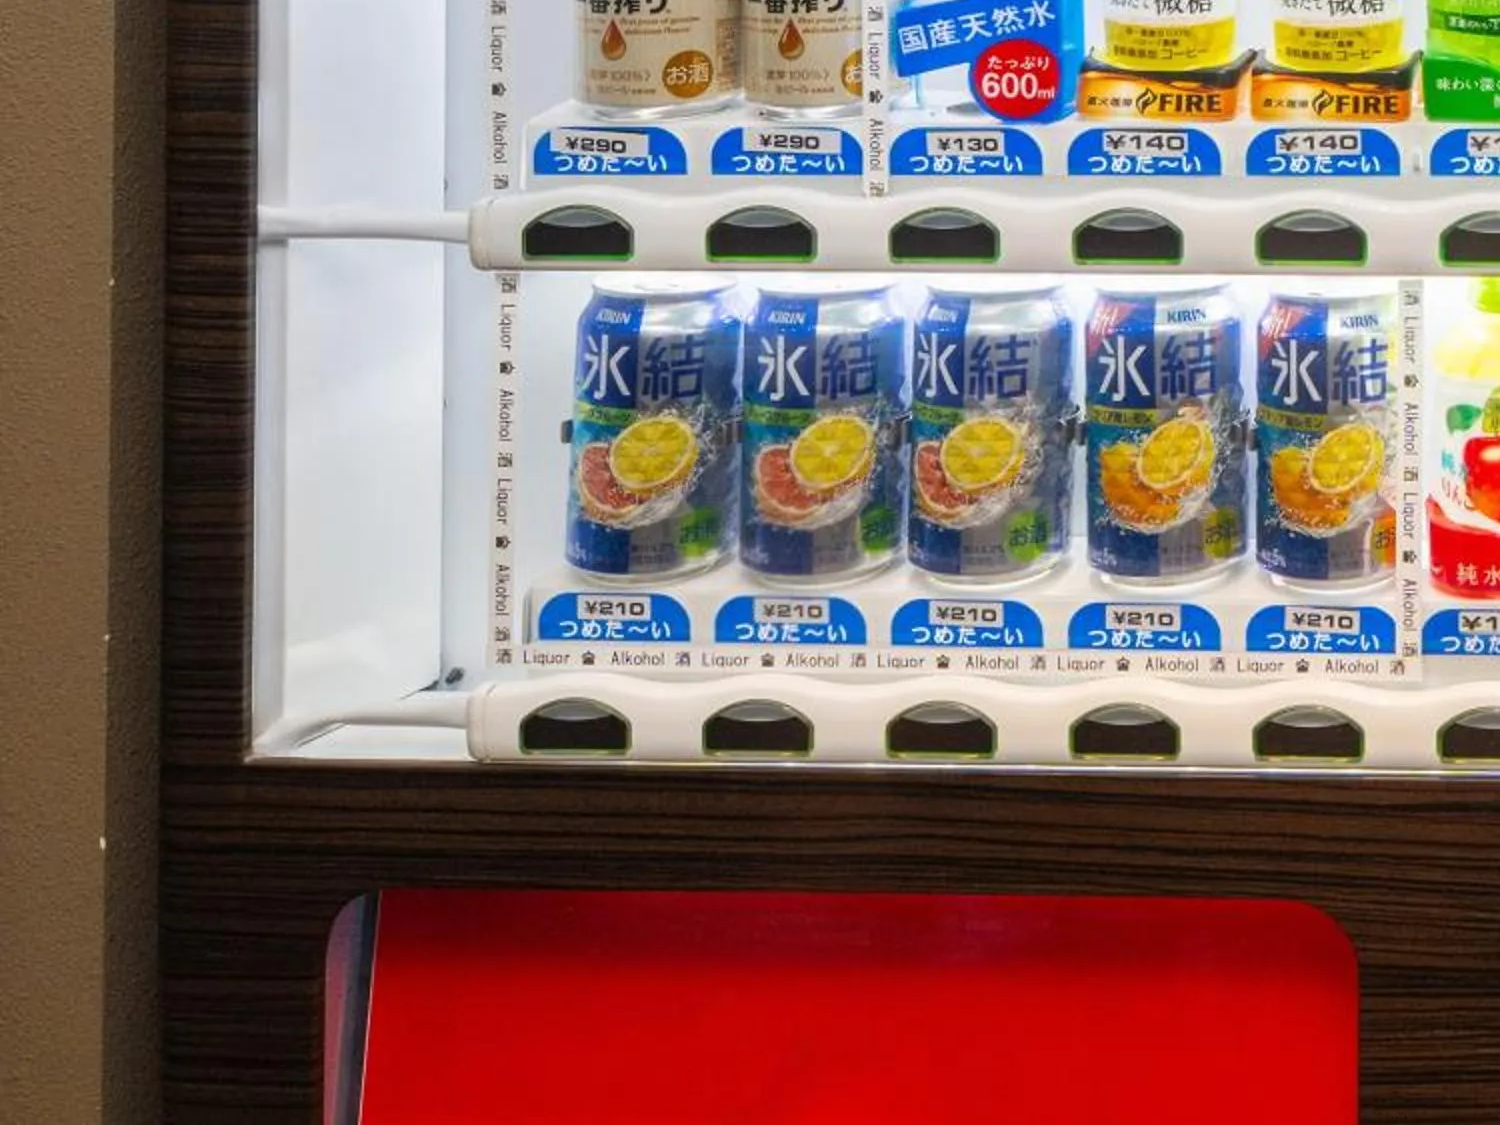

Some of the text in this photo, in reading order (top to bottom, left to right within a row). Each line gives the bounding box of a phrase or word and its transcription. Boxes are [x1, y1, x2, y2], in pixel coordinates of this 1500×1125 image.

[898, 0, 1056, 55] 国産天然水
[988, 56, 1051, 71] たっぷり
[981, 72, 1055, 100] 600ml
[1158, 93, 1223, 114] FIRE
[1335, 94, 1400, 115] FIRE
[565, 136, 628, 154] ¥290
[759, 133, 820, 150] ¥290
[937, 136, 999, 152] ¥130
[1105, 133, 1185, 151] ¥140
[1279, 135, 1359, 151] ¥140
[581, 333, 706, 401] 氷結
[757, 334, 879, 401] 氷結
[917, 332, 1033, 401] 氷結
[1098, 333, 1217, 401] 氷結
[1271, 337, 1389, 407] 氷結
[1402, 402, 1418, 540] Alkohol Liquor
[584, 601, 645, 617] ¥210
[762, 603, 823, 619] ¥210
[937, 606, 997, 622] ¥210
[1113, 610, 1175, 626] ¥210
[1292, 612, 1354, 630] ¥210
[522, 650, 1379, 674] Liquor Alkohol Liquor Alkohol Liquor Alkohol Liquor Alkohol Liquor Alkohol
